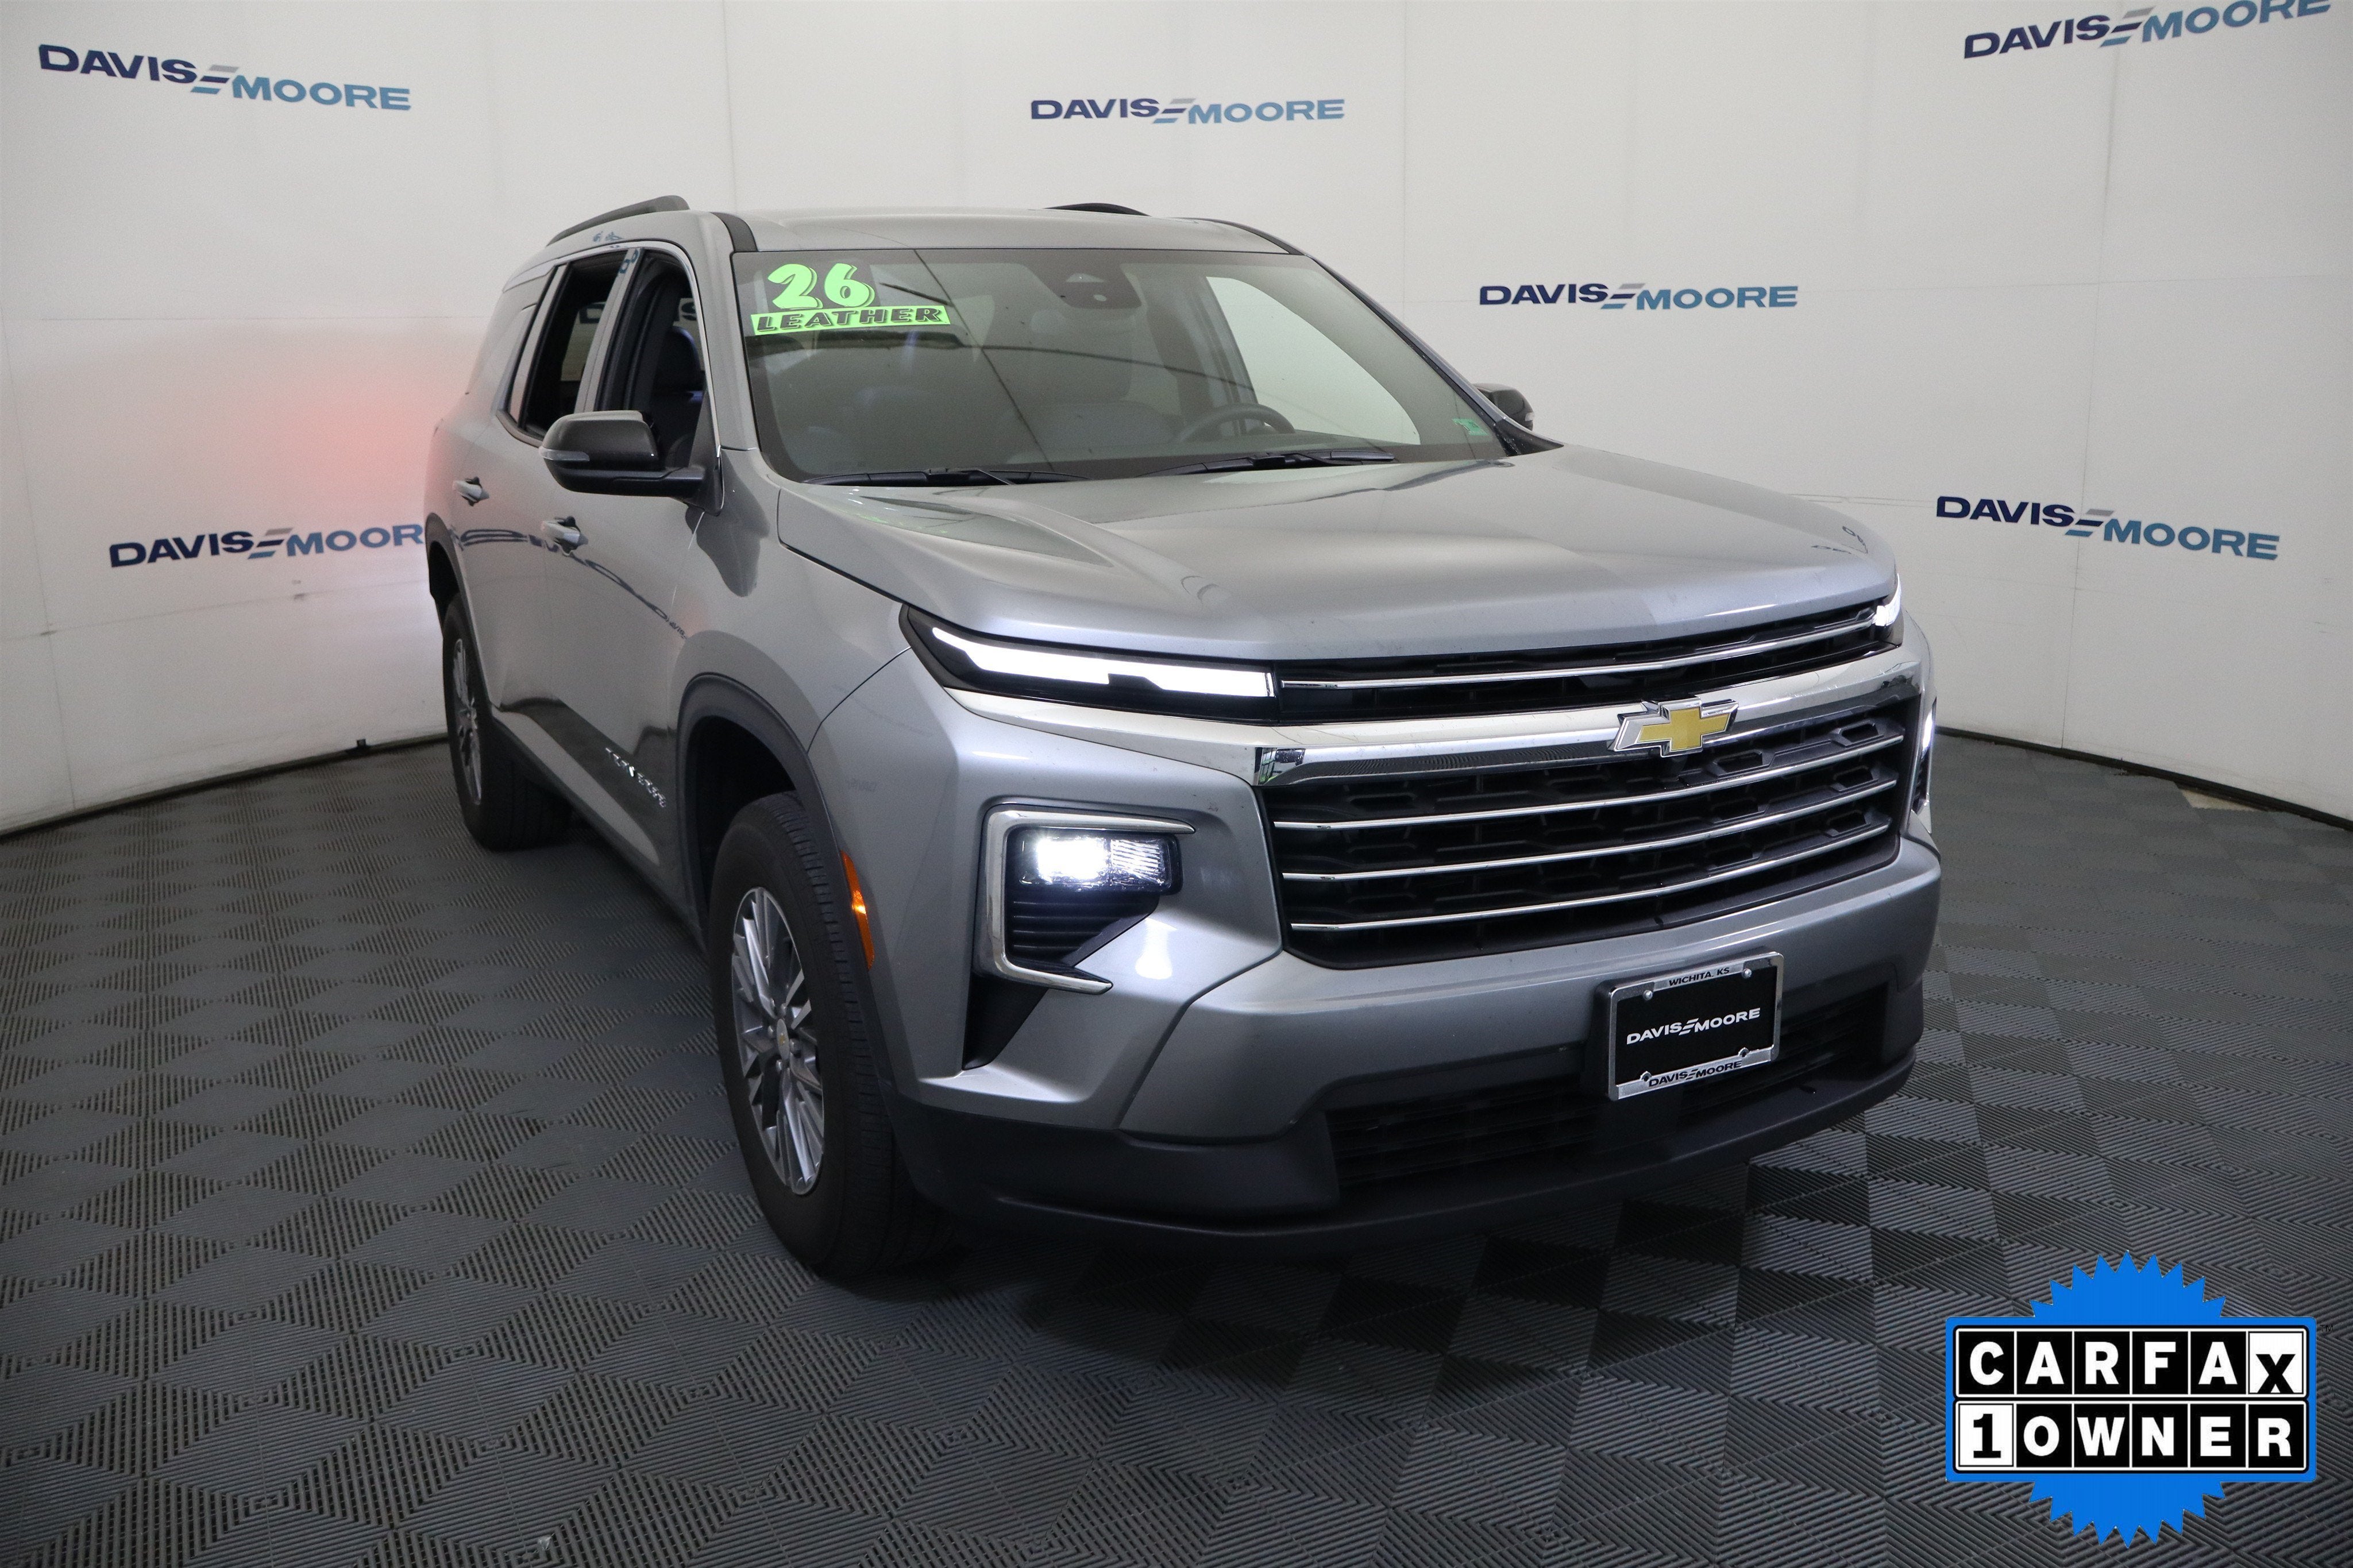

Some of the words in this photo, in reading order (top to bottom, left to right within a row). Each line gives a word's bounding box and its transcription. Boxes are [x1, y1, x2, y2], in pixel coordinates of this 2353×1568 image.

[1964, 14, 2111, 59] DAVIS
[38, 44, 198, 84] DAVIS
[232, 74, 411, 111] MOORE
[1031, 98, 1160, 119] DAVIS
[1187, 98, 1345, 125] MOORE
[767, 262, 875, 309] 26
[1479, 283, 1609, 306] DAVIS
[1635, 285, 1799, 310] MOORE
[757, 307, 942, 332] LEATHER
[109, 531, 254, 568] DAVIS
[286, 523, 424, 557] MOOR
[1936, 496, 2075, 527] DAVIS
[2103, 518, 2281, 561] MOORE
[1716, 967, 1730, 976] KS
[1626, 1022, 1682, 1045] DAVIS
[1694, 1007, 1761, 1033] MOORE
[1648, 1070, 1688, 1087] DAVIS
[1695, 1060, 1742, 1079] MOORE
